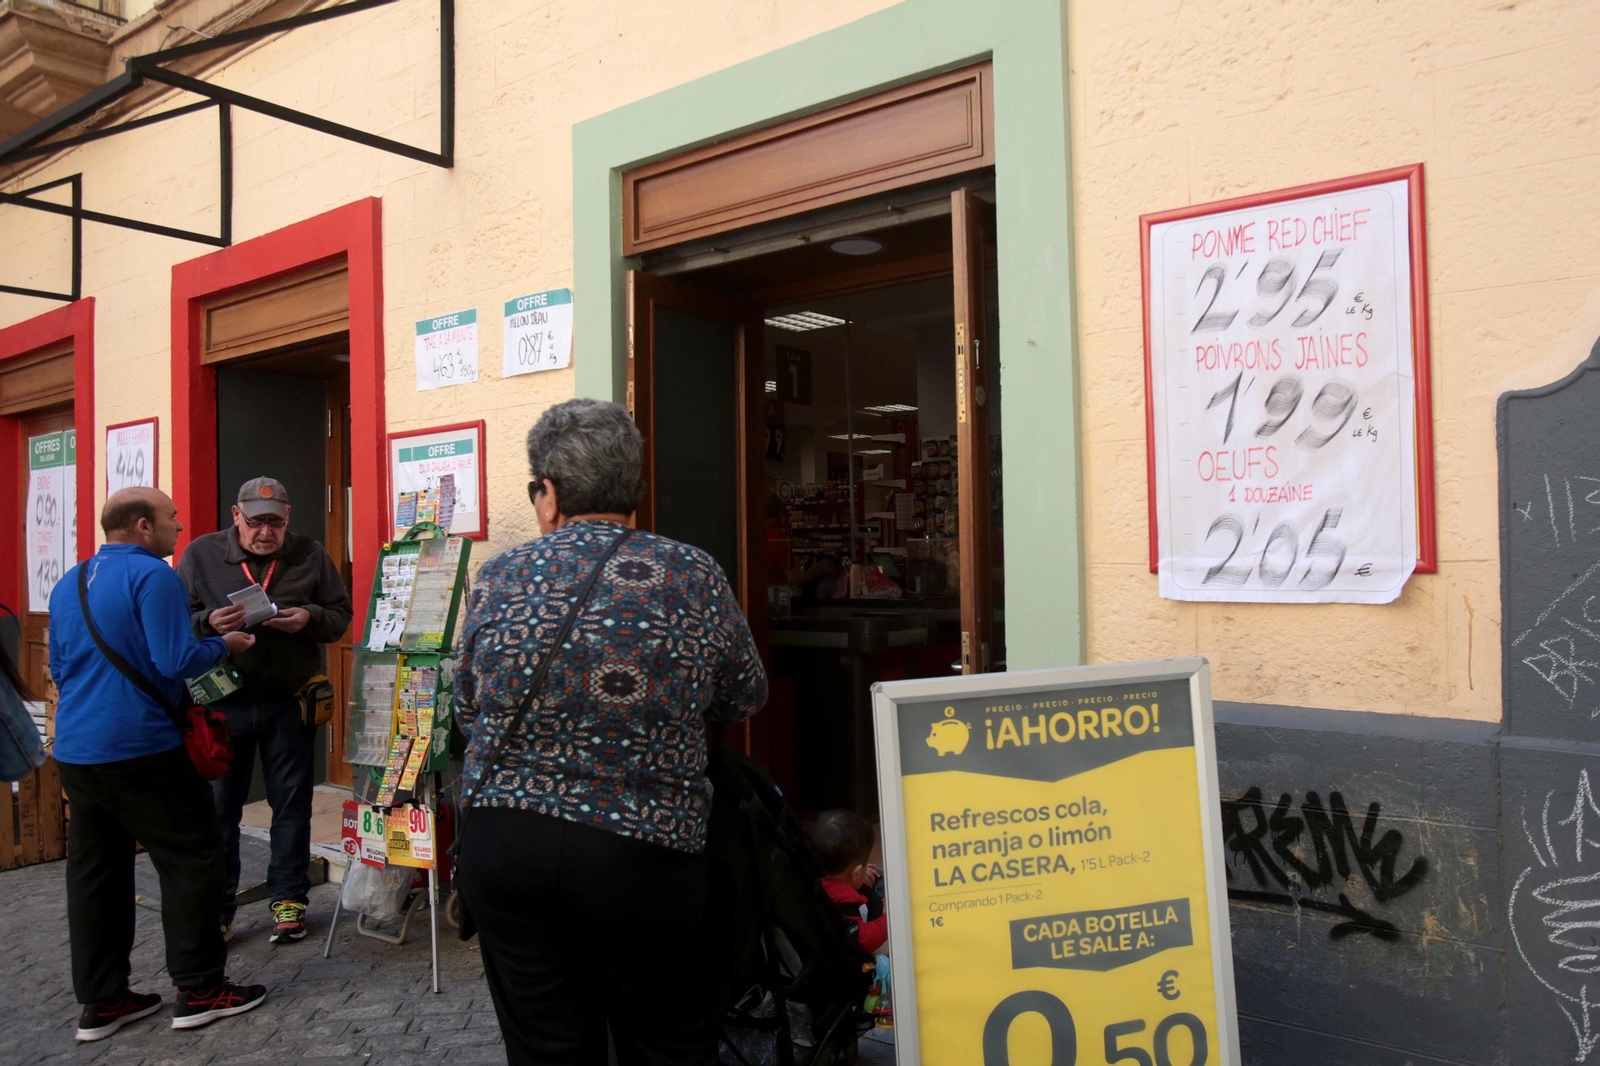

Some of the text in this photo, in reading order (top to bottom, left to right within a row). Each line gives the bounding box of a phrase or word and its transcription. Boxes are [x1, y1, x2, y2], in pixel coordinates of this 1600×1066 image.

[1267, 217, 1307, 251] RED
[1312, 207, 1371, 246] CHIEF
[517, 293, 548, 311] OFFRE
[432, 314, 459, 330] OFFRE
[1195, 337, 1283, 372] POIVRONS
[35, 438, 61, 454] OFFRES
[428, 443, 456, 457] OFFRE
[1197, 445, 1279, 482] OEUFS
[1244, 481, 1314, 504] DOUZAINE
[985, 691, 1158, 714] PRECIO PRECIO PRECIO PRECIO
[985, 703, 1160, 750] ¡AHORRO!
[343, 818, 358, 830] BOT
[409, 808, 427, 834] 90
[930, 796, 1108, 833] Refrescos cola,
[932, 822, 1112, 860] naranja o limón
[933, 864, 967, 888] LA
[971, 853, 1076, 883] CASERA,
[1108, 851, 1151, 867] Pack-2
[929, 889, 1044, 913] Comprando 1 Pack-2
[929, 916, 944, 928] 1€
[1023, 906, 1179, 943] CADA BOTELLA
[1051, 931, 1155, 960] LE SALE A:
[1157, 969, 1181, 1000] €
